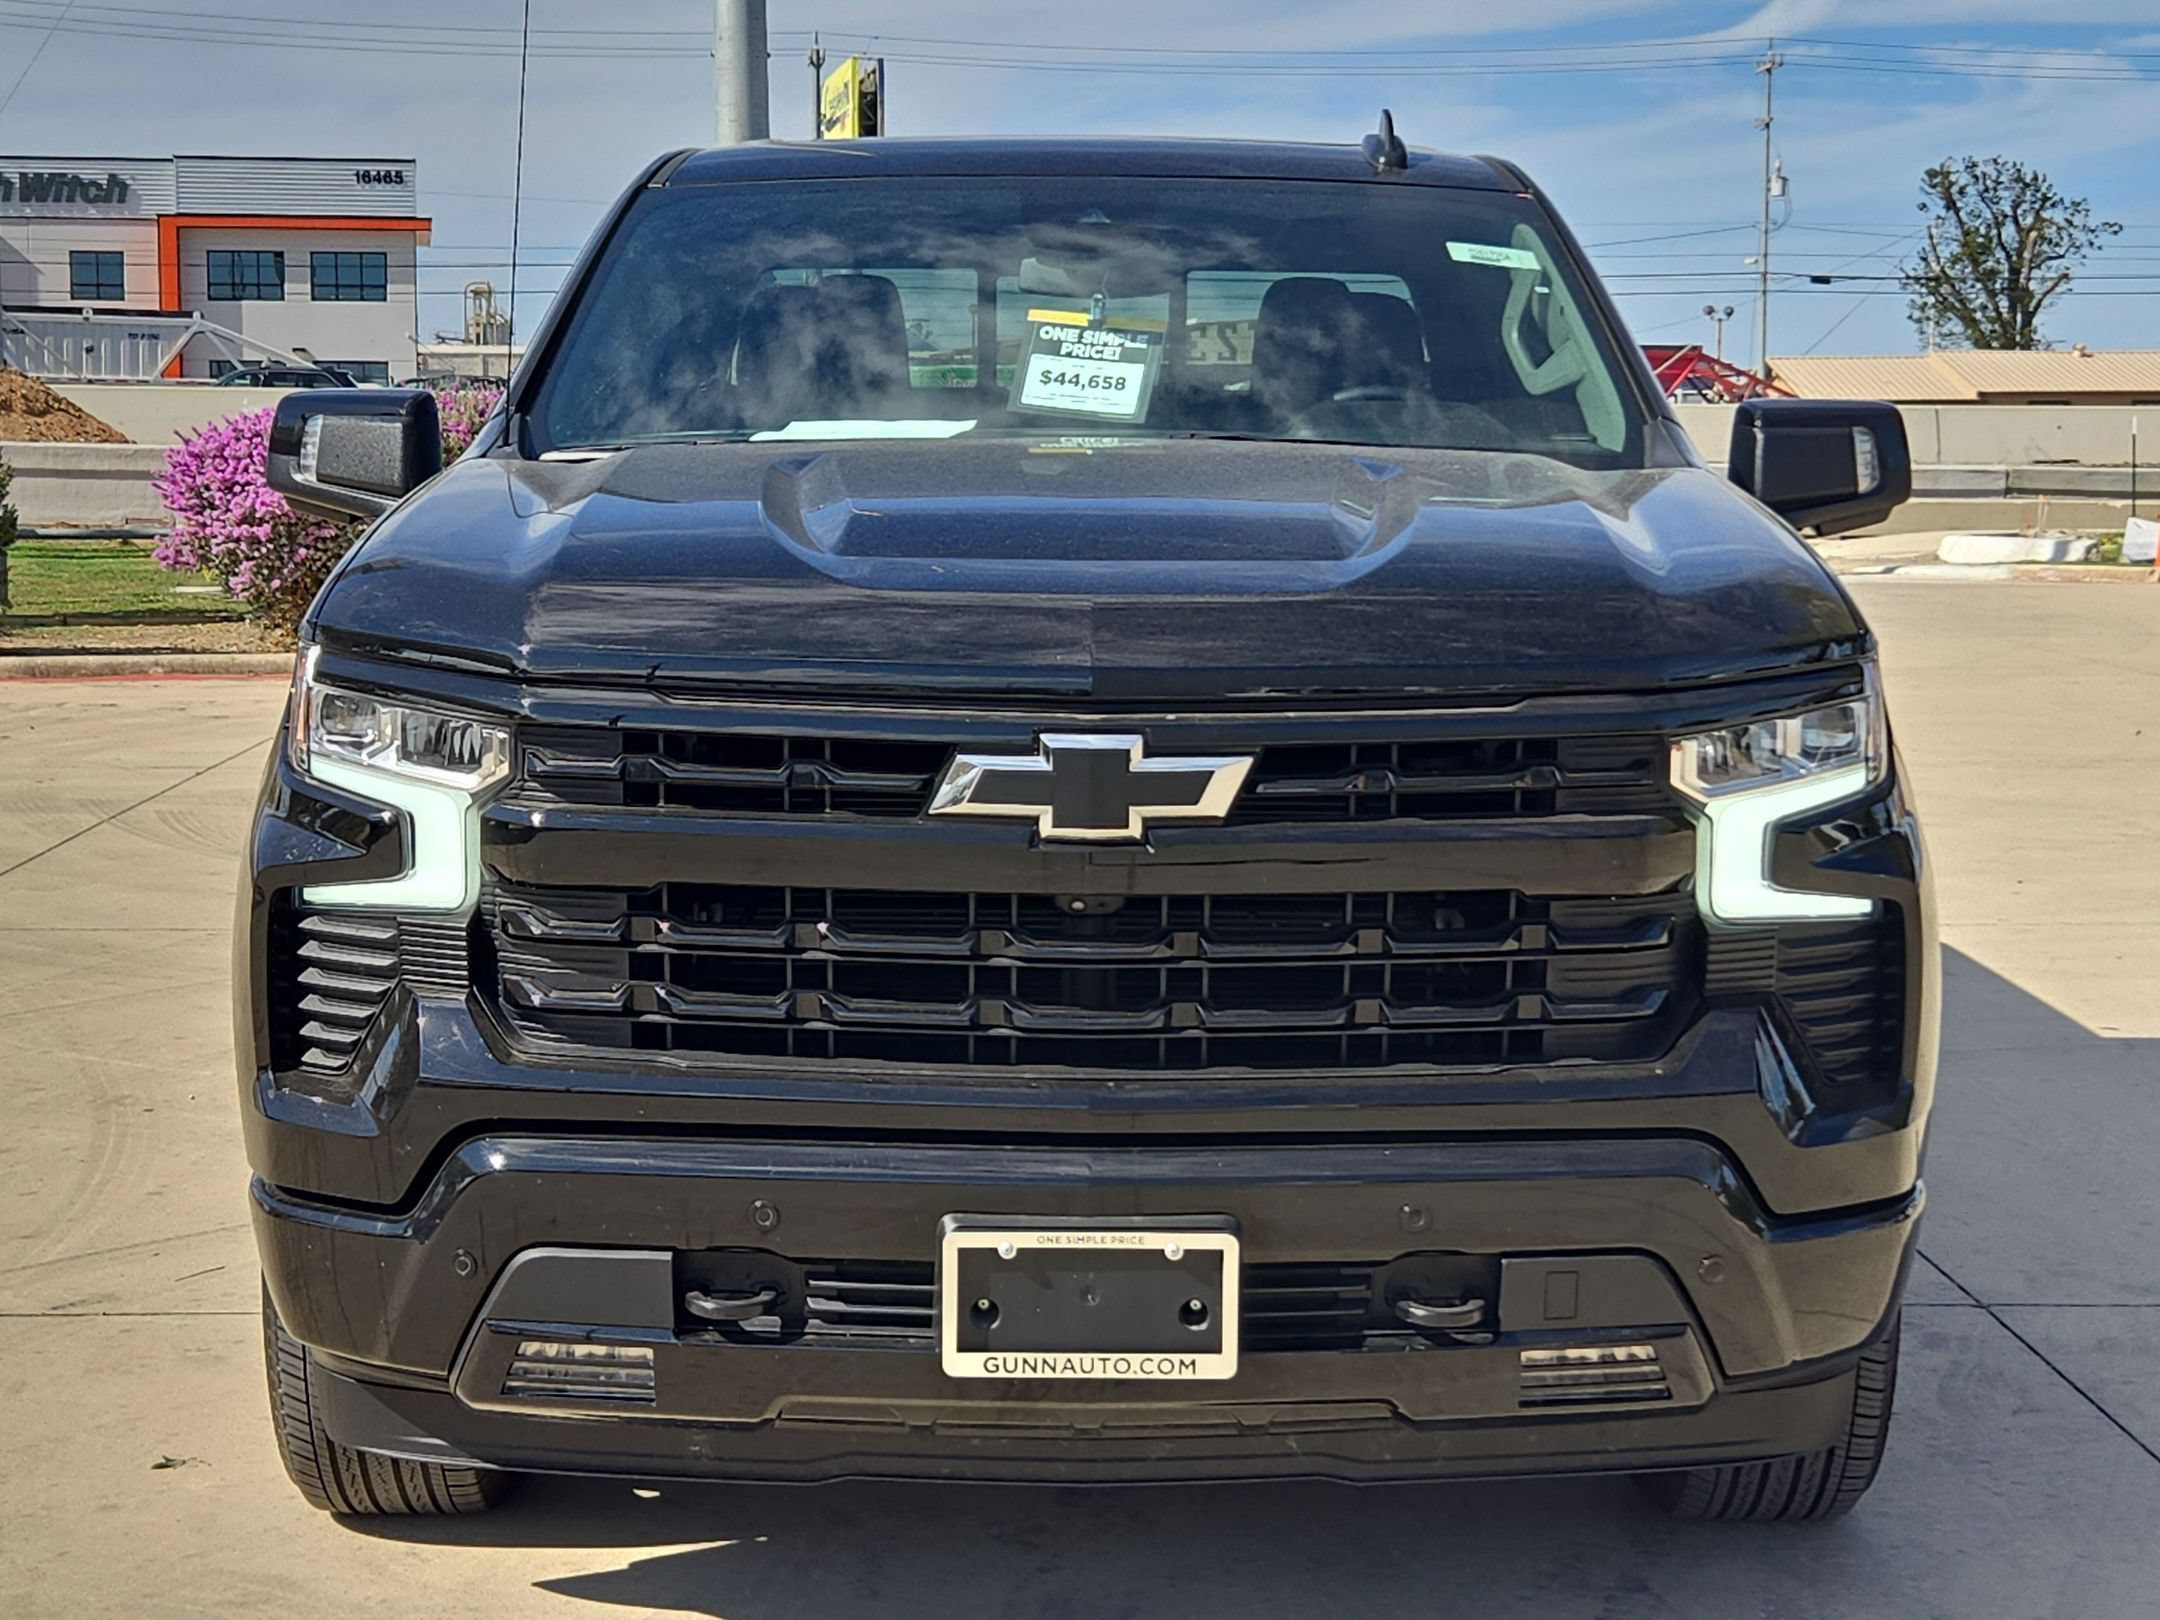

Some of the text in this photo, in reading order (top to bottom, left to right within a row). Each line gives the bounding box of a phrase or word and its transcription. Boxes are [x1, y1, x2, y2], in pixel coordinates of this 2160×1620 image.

[353, 169, 404, 185] 16465
[18, 172, 129, 204] Witch
[1039, 325, 1149, 349] ONE SIMPLE
[1059, 342, 1122, 361] PRICE!
[1039, 369, 1126, 391] $44,658
[1036, 1235, 1146, 1246] ONE SIMPLE PRICE
[983, 1356, 1197, 1376] GUNNAUTO.COM
